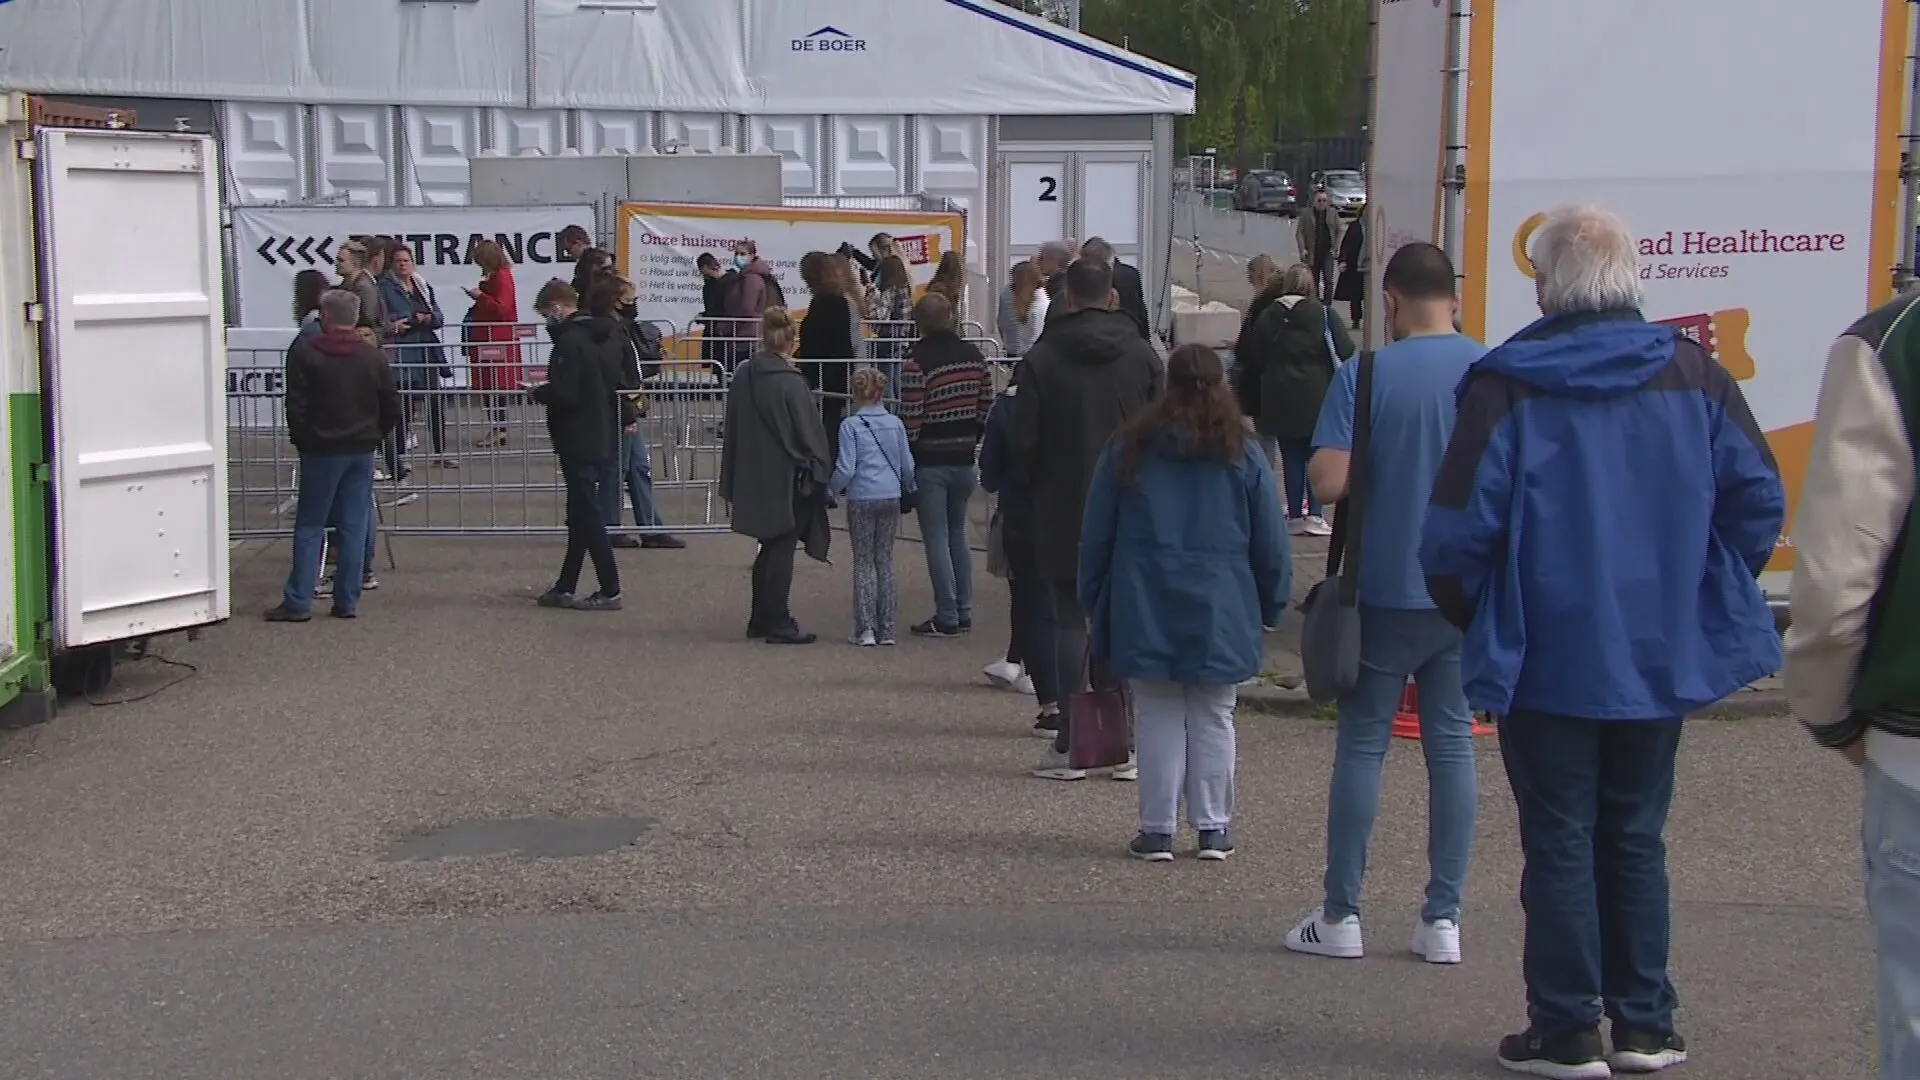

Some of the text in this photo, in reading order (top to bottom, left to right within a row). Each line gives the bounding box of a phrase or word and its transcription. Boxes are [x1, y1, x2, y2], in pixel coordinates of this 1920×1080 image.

[791, 39, 866, 51] DE BOER
[1038, 176, 1057, 201] 2
[348, 232, 577, 265] TRANCE
[640, 233, 755, 252] Onze huisrege
[1638, 228, 1846, 256] ad Healthcare
[1655, 262, 1729, 280] Services
[677, 281, 703, 291] verbo
